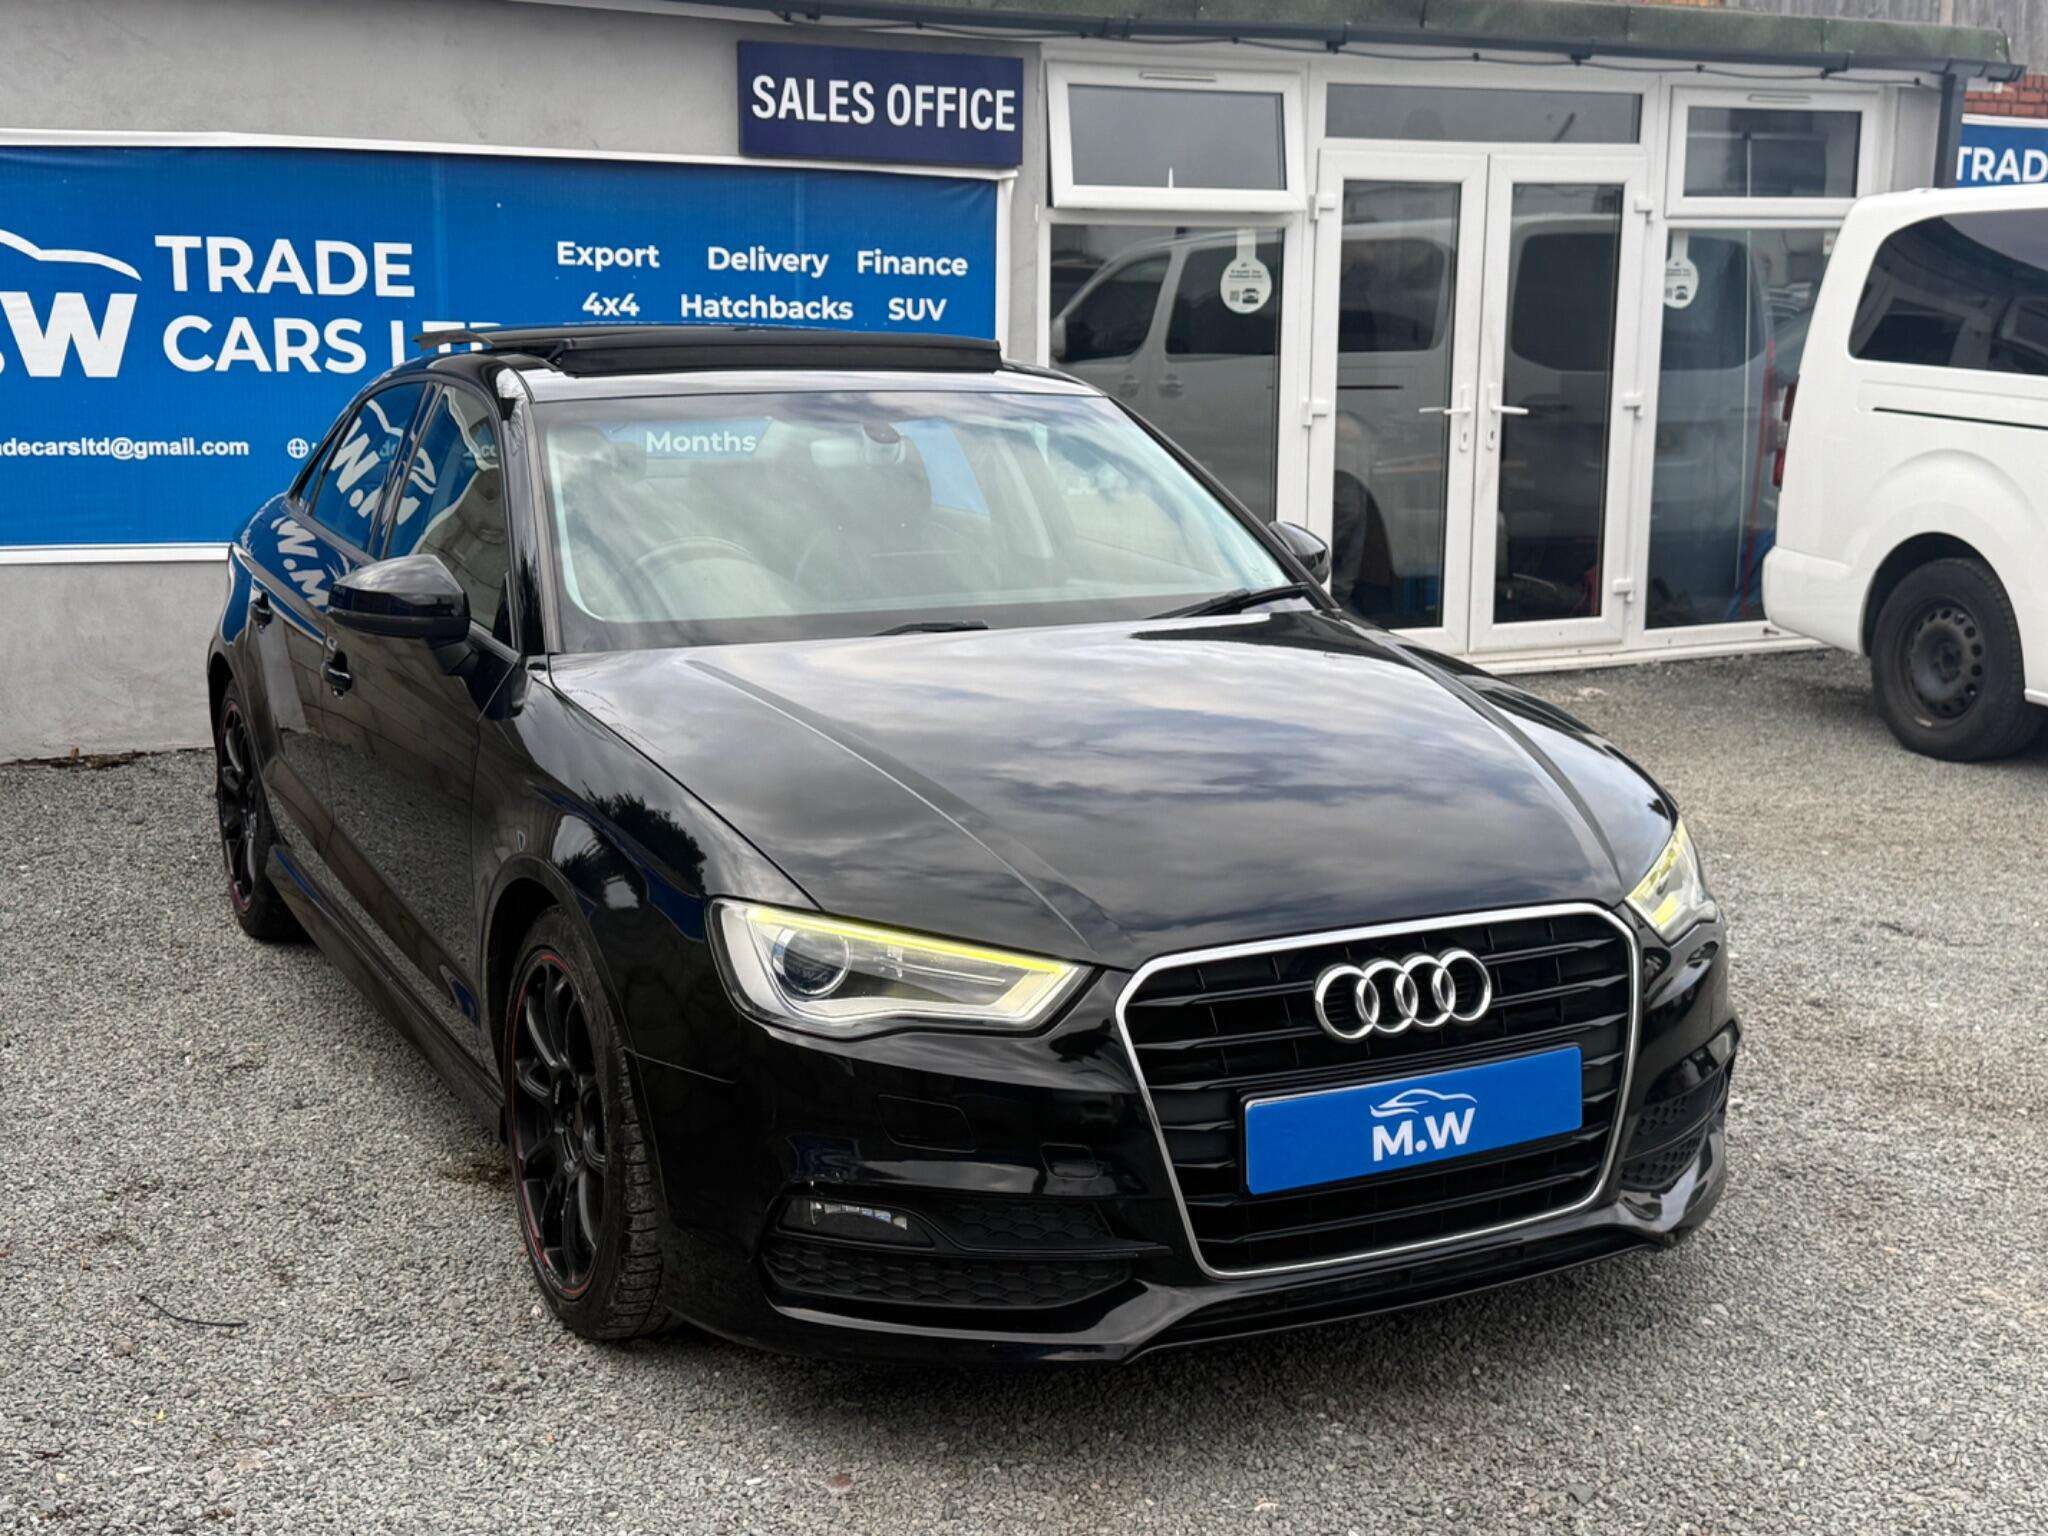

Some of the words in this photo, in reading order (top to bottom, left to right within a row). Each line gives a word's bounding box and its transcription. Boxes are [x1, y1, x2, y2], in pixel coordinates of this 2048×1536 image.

[753, 75, 875, 124] SALES
[886, 83, 1016, 131] OFFICE
[155, 235, 415, 297] TRADE
[557, 241, 660, 272] Export
[707, 246, 829, 278] Delivery
[857, 249, 969, 276] Finance
[583, 292, 640, 317] 4x4
[681, 294, 853, 321] Hatchbacks
[888, 298, 947, 321] SUV
[0, 291, 138, 378] W
[163, 315, 367, 374] CARS
[0, 436, 249, 460] decarsltd@gmail.com
[646, 430, 756, 453] Months
[1373, 1107, 1476, 1162] M.W
